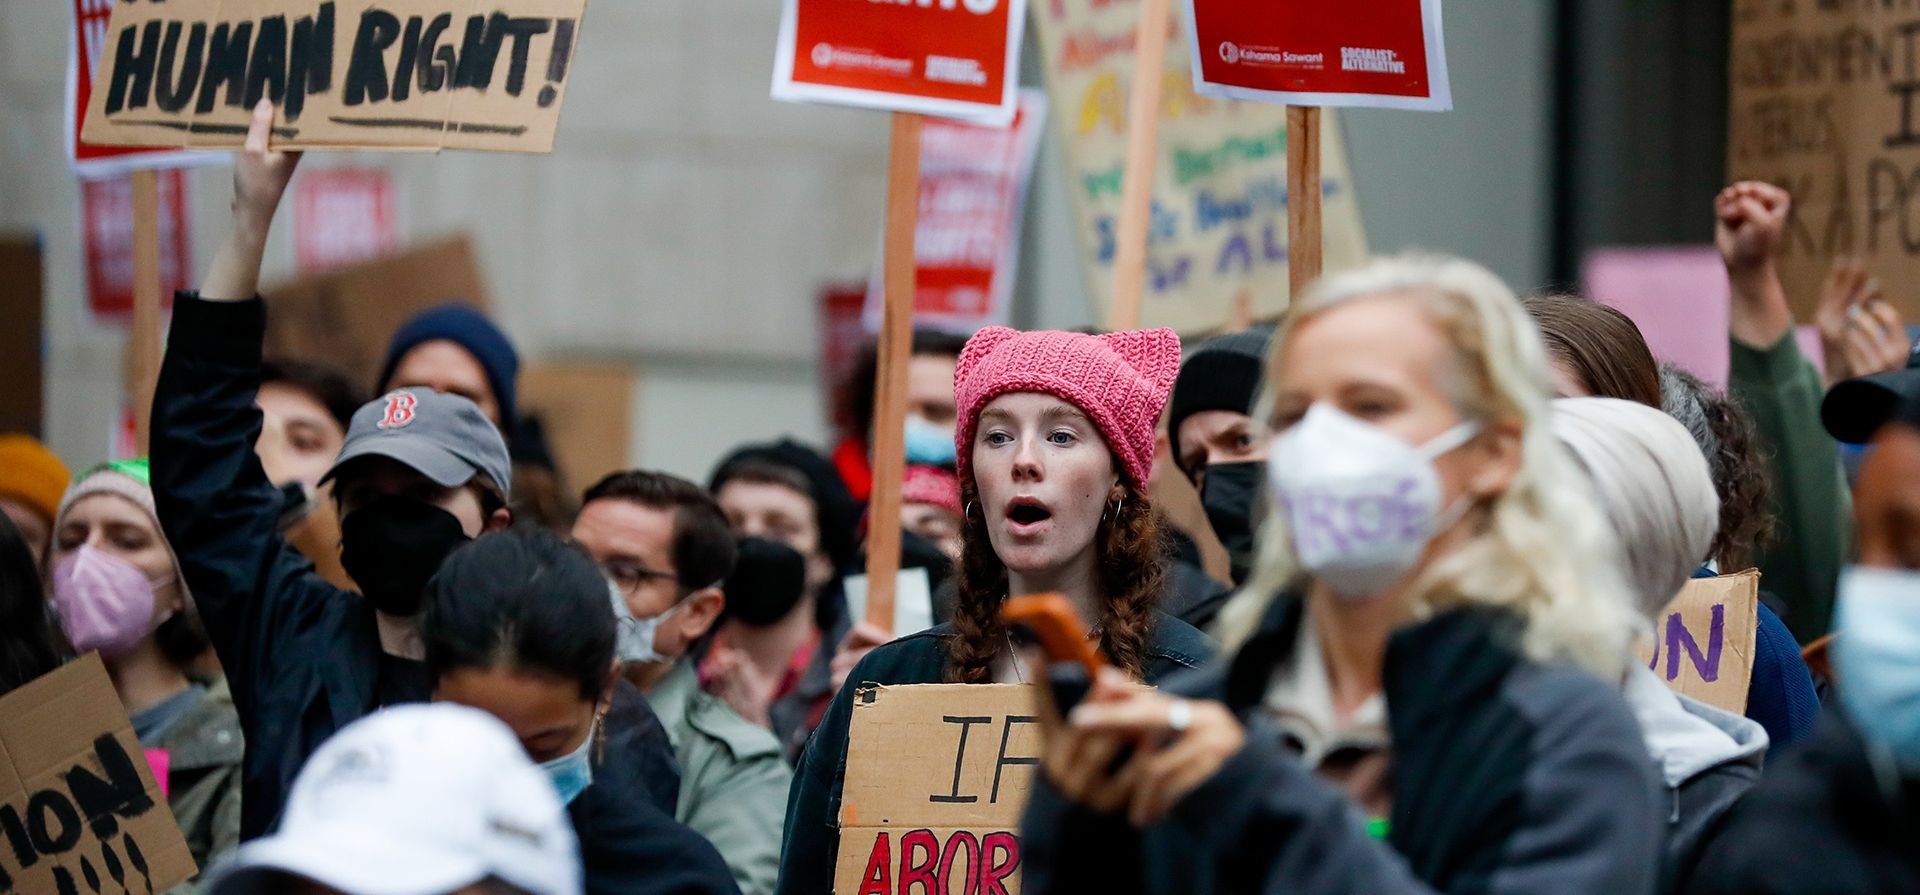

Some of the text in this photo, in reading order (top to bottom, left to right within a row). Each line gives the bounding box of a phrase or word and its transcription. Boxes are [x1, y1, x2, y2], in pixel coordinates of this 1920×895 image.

[105, 1, 335, 123] HUMAN
[343, 10, 576, 107] RIGHT!
[1240, 49, 1323, 64] Kshama Sawant
[1341, 47, 1394, 61] SOCIALIST
[1342, 58, 1405, 74] ALTERNATIVE
[377, 391, 417, 429] B
[1650, 604, 1724, 683] N
[929, 715, 1040, 804] IF
